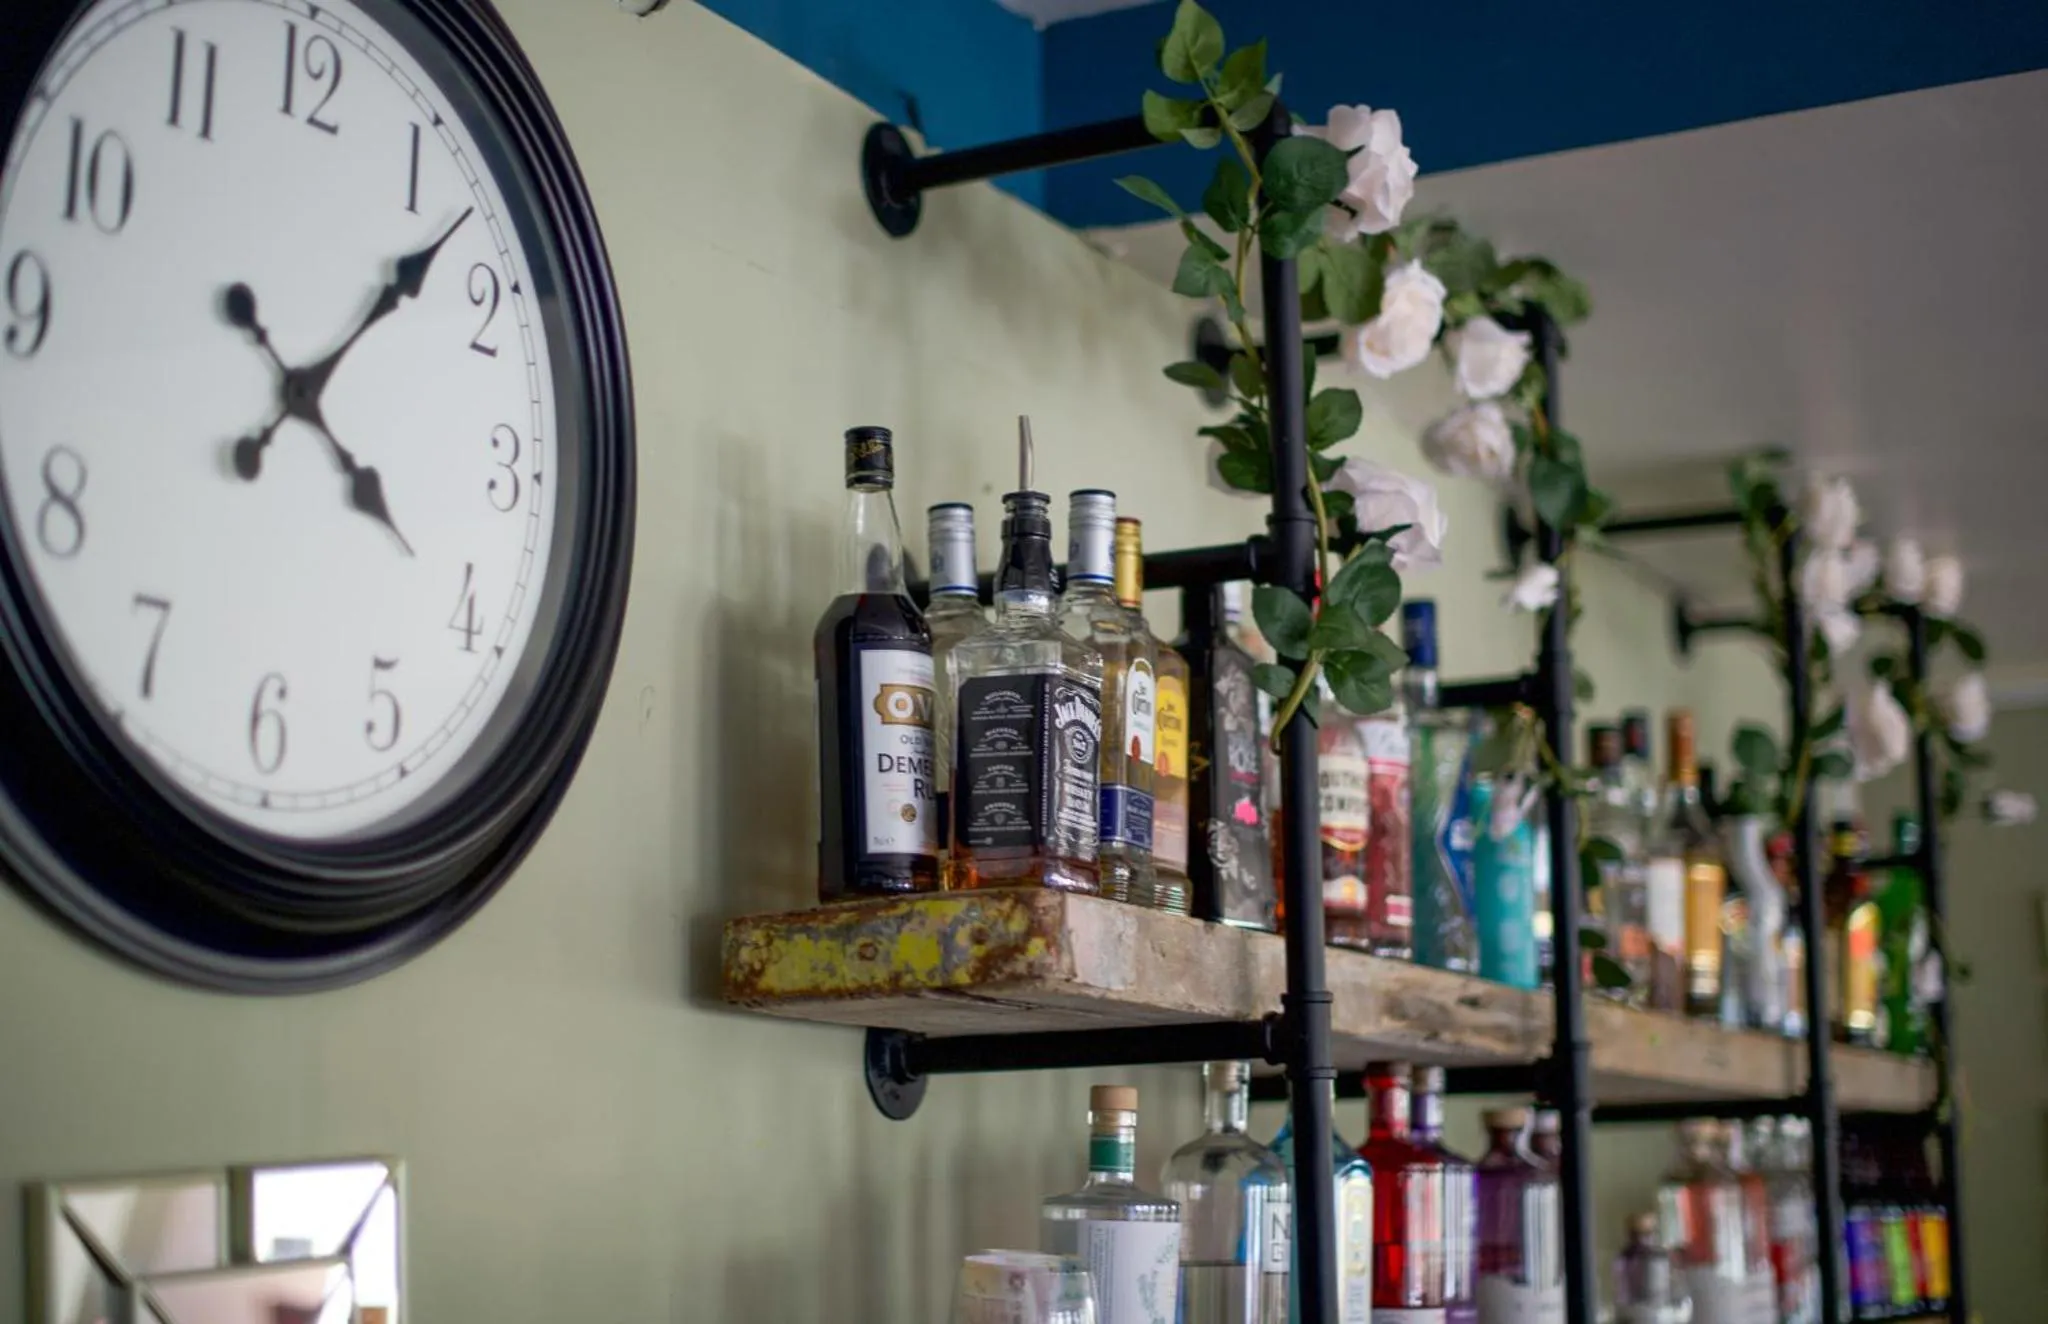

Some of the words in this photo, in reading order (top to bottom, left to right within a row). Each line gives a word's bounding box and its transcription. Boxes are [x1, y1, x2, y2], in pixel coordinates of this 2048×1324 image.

[165, 26, 217, 142] 11
[279, 20, 342, 135] 12
[61, 116, 134, 235] 10
[404, 122, 420, 215] 1
[5, 249, 51, 359] 9
[468, 262, 500, 358] 2
[38, 445, 87, 560] 8
[488, 424, 520, 512] 3
[131, 593, 171, 700] 7
[447, 562, 484, 653] 4
[249, 672, 287, 774] 6
[365, 656, 402, 752] 5
